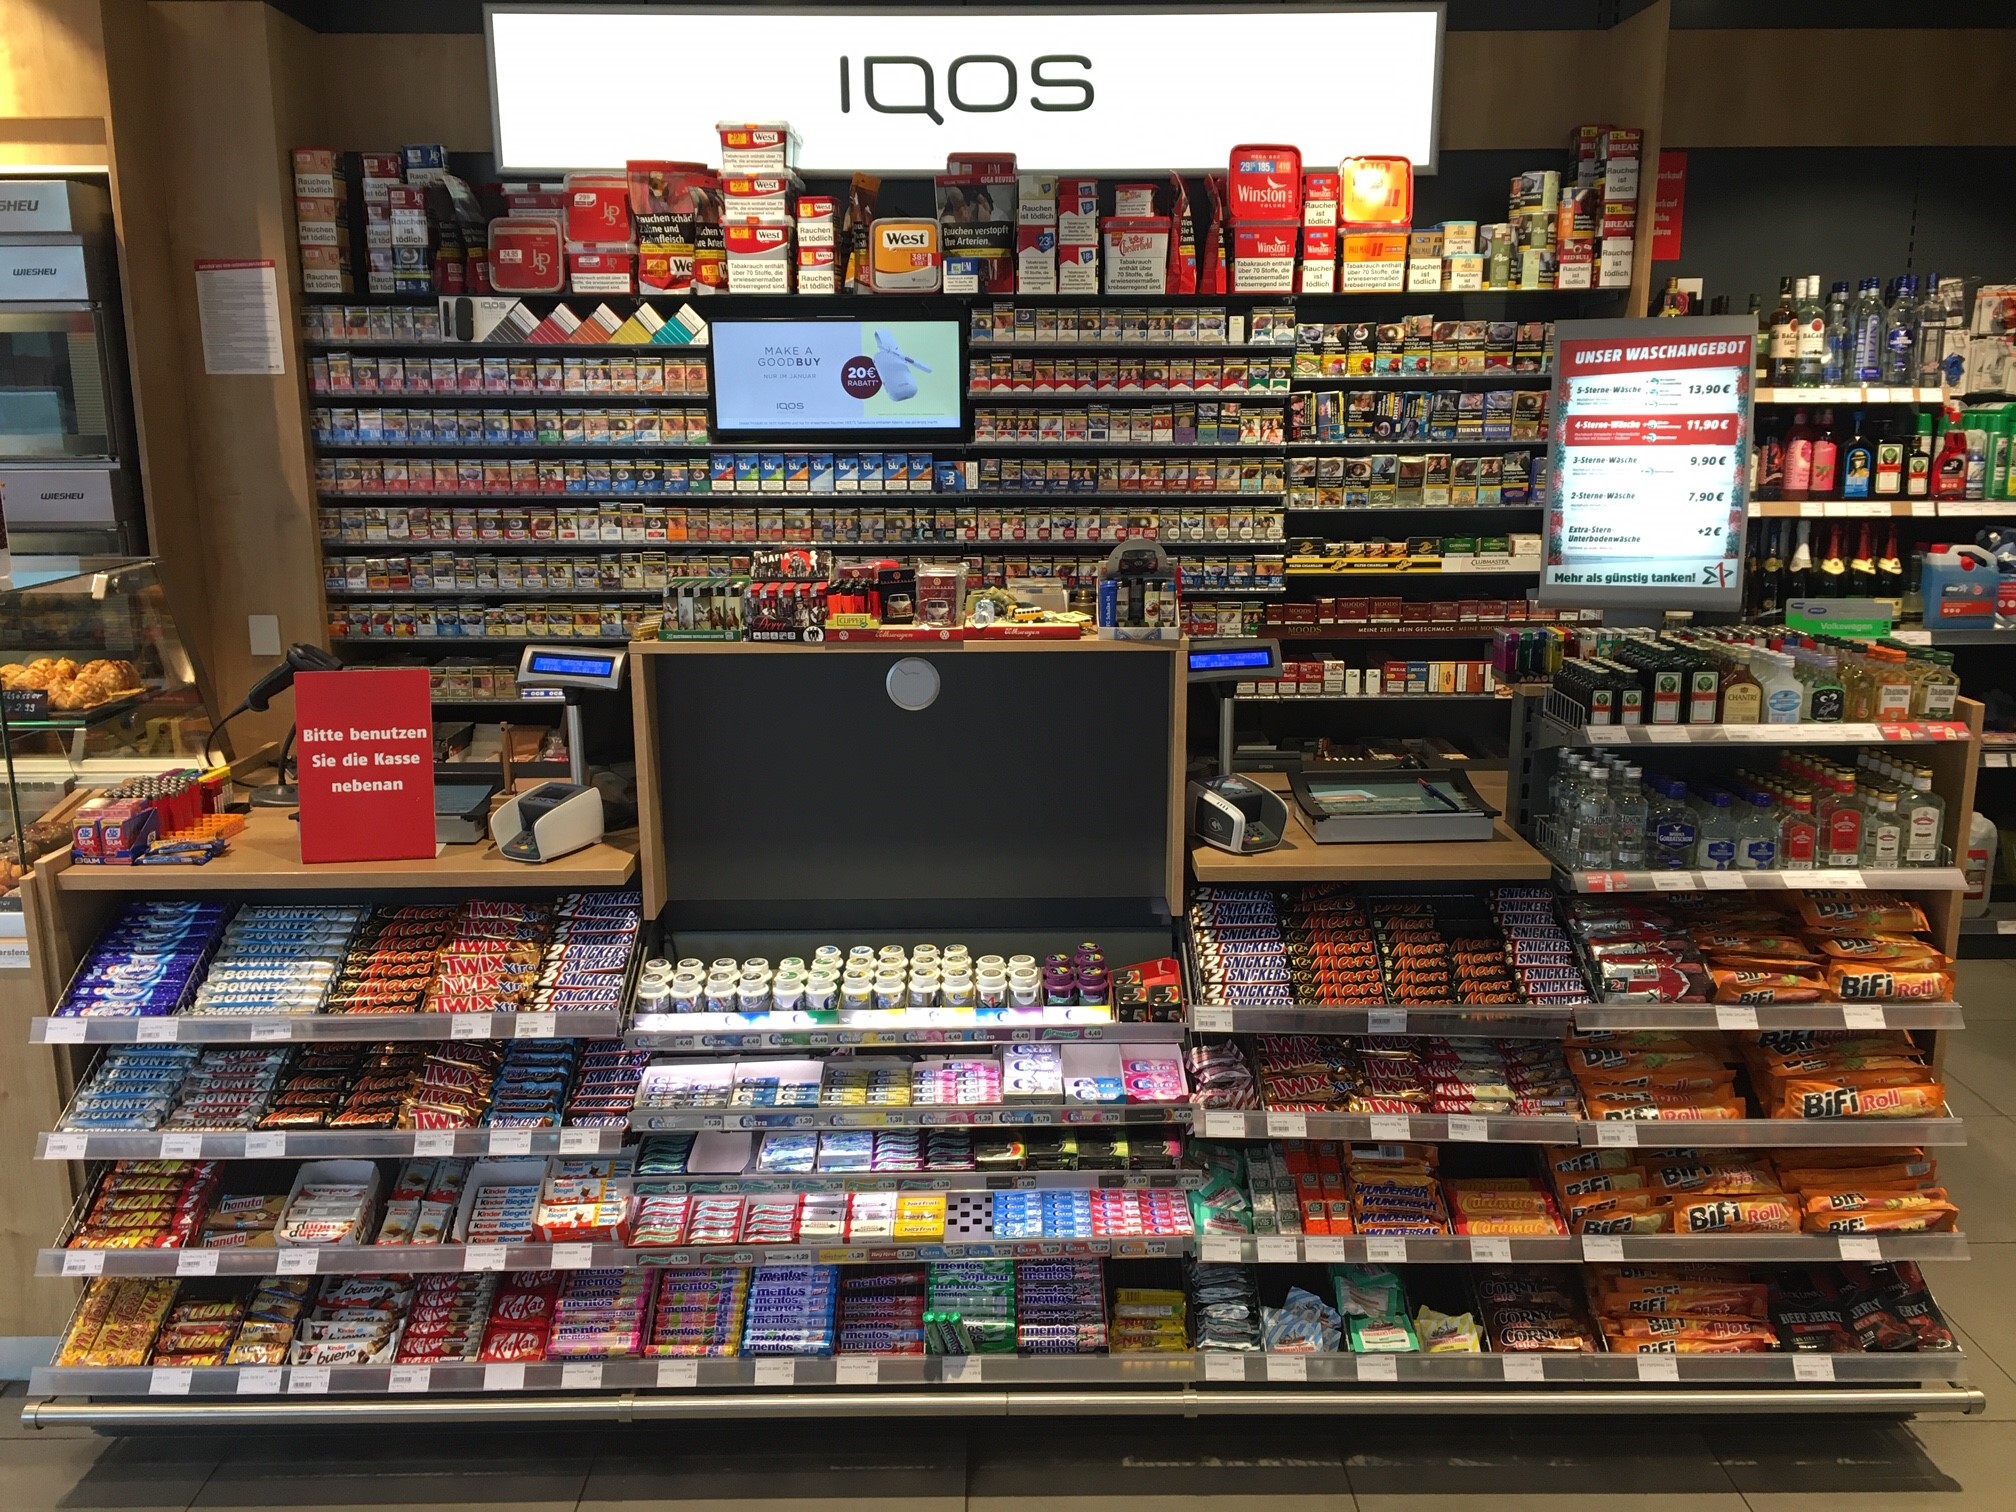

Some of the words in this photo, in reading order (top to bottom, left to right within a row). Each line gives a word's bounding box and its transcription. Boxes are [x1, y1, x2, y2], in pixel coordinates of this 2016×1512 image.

[840, 54, 1095, 126] IQOS
[1609, 143, 1639, 151] BREAK
[1607, 167, 1638, 175] Rauchen
[1237, 184, 1286, 202] Winston
[1309, 190, 1330, 198] Winston
[1609, 184, 1634, 193] tödlich
[1030, 213, 1054, 221] tödlich
[1605, 220, 1635, 228] BREAK
[758, 231, 781, 239] West
[944, 228, 973, 237] Rauchen
[974, 227, 1009, 238] verstopft
[395, 235, 424, 244] tödlich
[886, 233, 925, 245] West
[957, 237, 992, 246] Arterien.
[1257, 241, 1286, 253] Winston
[1237, 260, 1266, 268] Tabakrauch
[12, 268, 57, 276] WIESHEU
[306, 273, 339, 281] Rauchen
[316, 281, 341, 289] tödlich
[764, 346, 800, 355] MAKE
[805, 346, 813, 355] A
[1575, 349, 1622, 365] UNSER
[1626, 340, 1747, 362] WASCHANGEBOT
[758, 357, 821, 367] GOODBUY
[847, 366, 876, 379] 20€
[1577, 386, 1642, 394] 5-Sterne-Wäsche
[1688, 384, 1720, 395] 13,90
[1722, 384, 1731, 394] €
[776, 402, 805, 410] IQOS
[1575, 420, 1641, 429] 4-Sterne-Wäsche
[1687, 419, 1720, 431] 11,90
[1721, 419, 1730, 430] €
[737, 463, 749, 471] blu
[863, 463, 875, 471] blu
[1573, 456, 1638, 464] 3-Sterne-Wäsche
[1690, 456, 1717, 467] 9,90
[1719, 456, 1727, 465] €
[40, 492, 84, 501] WIESHEU
[1571, 492, 1636, 500] 2-Sterne-Wäsche
[1688, 492, 1715, 502] 7,90
[1716, 492, 1725, 501] €
[1697, 527, 1712, 536] +2
[1713, 527, 1722, 536] €
[1568, 535, 1641, 543] Unterbodenwäsche
[760, 553, 790, 564] MAFIA
[1555, 573, 1584, 583] Mehr
[1586, 573, 1603, 583] als
[1605, 573, 1649, 584] günstig
[1651, 573, 1696, 583] tanken!
[840, 617, 866, 625] CLIPPER
[1288, 626, 1322, 634] MOODS
[1821, 622, 1873, 632] Volkswagen
[875, 630, 914, 640] Volkswagen
[303, 729, 344, 741] Bitte
[349, 726, 427, 740] benutzen
[312, 754, 338, 767] Sie
[342, 753, 368, 766] die
[374, 752, 421, 765] Kasse
[331, 778, 403, 793] nebenan
[581, 893, 641, 906] SNICKERS
[255, 908, 321, 919] BOUNTY
[469, 901, 526, 918] TWIX
[1222, 942, 1284, 954] SNICKERS
[1309, 941, 1373, 955] Mars
[1393, 942, 1446, 956] Mars
[361, 962, 433, 978] Mars
[442, 954, 506, 976] TWIX
[503, 963, 535, 974] Xtra
[215, 982, 282, 993] BOUNTY
[1841, 974, 1893, 998] BiFi
[1897, 979, 1934, 997] Roll
[553, 988, 619, 1002] SNICKERS
[585, 1069, 644, 1083] SNICKERS
[1264, 1073, 1330, 1096] TWIX
[1803, 1088, 1859, 1118] BiFi
[1862, 1088, 1900, 1110] Roll
[257, 1111, 324, 1126] Mars
[1363, 1196, 1438, 1211] WUNDERBAR
[1461, 1195, 1532, 1213] Caramac
[502, 1210, 527, 1219] Riegel
[1689, 1201, 1742, 1232] BiFi
[1747, 1204, 1780, 1223] Roll
[204, 1233, 246, 1247] hanuta
[936, 1262, 984, 1271] mentos
[668, 1281, 717, 1291] mentos
[848, 1277, 897, 1288] mentos
[190, 1303, 234, 1318] LION
[499, 1295, 546, 1317] KitKat
[1779, 1313, 1807, 1325] BEEF
[1807, 1311, 1844, 1325] JERKY
[1026, 1325, 1076, 1336] mentos
[1714, 1322, 1751, 1337] Hot
[1501, 1328, 1562, 1344] CORNY
[490, 1334, 538, 1359] KitKat
[317, 1349, 356, 1364] bueno
